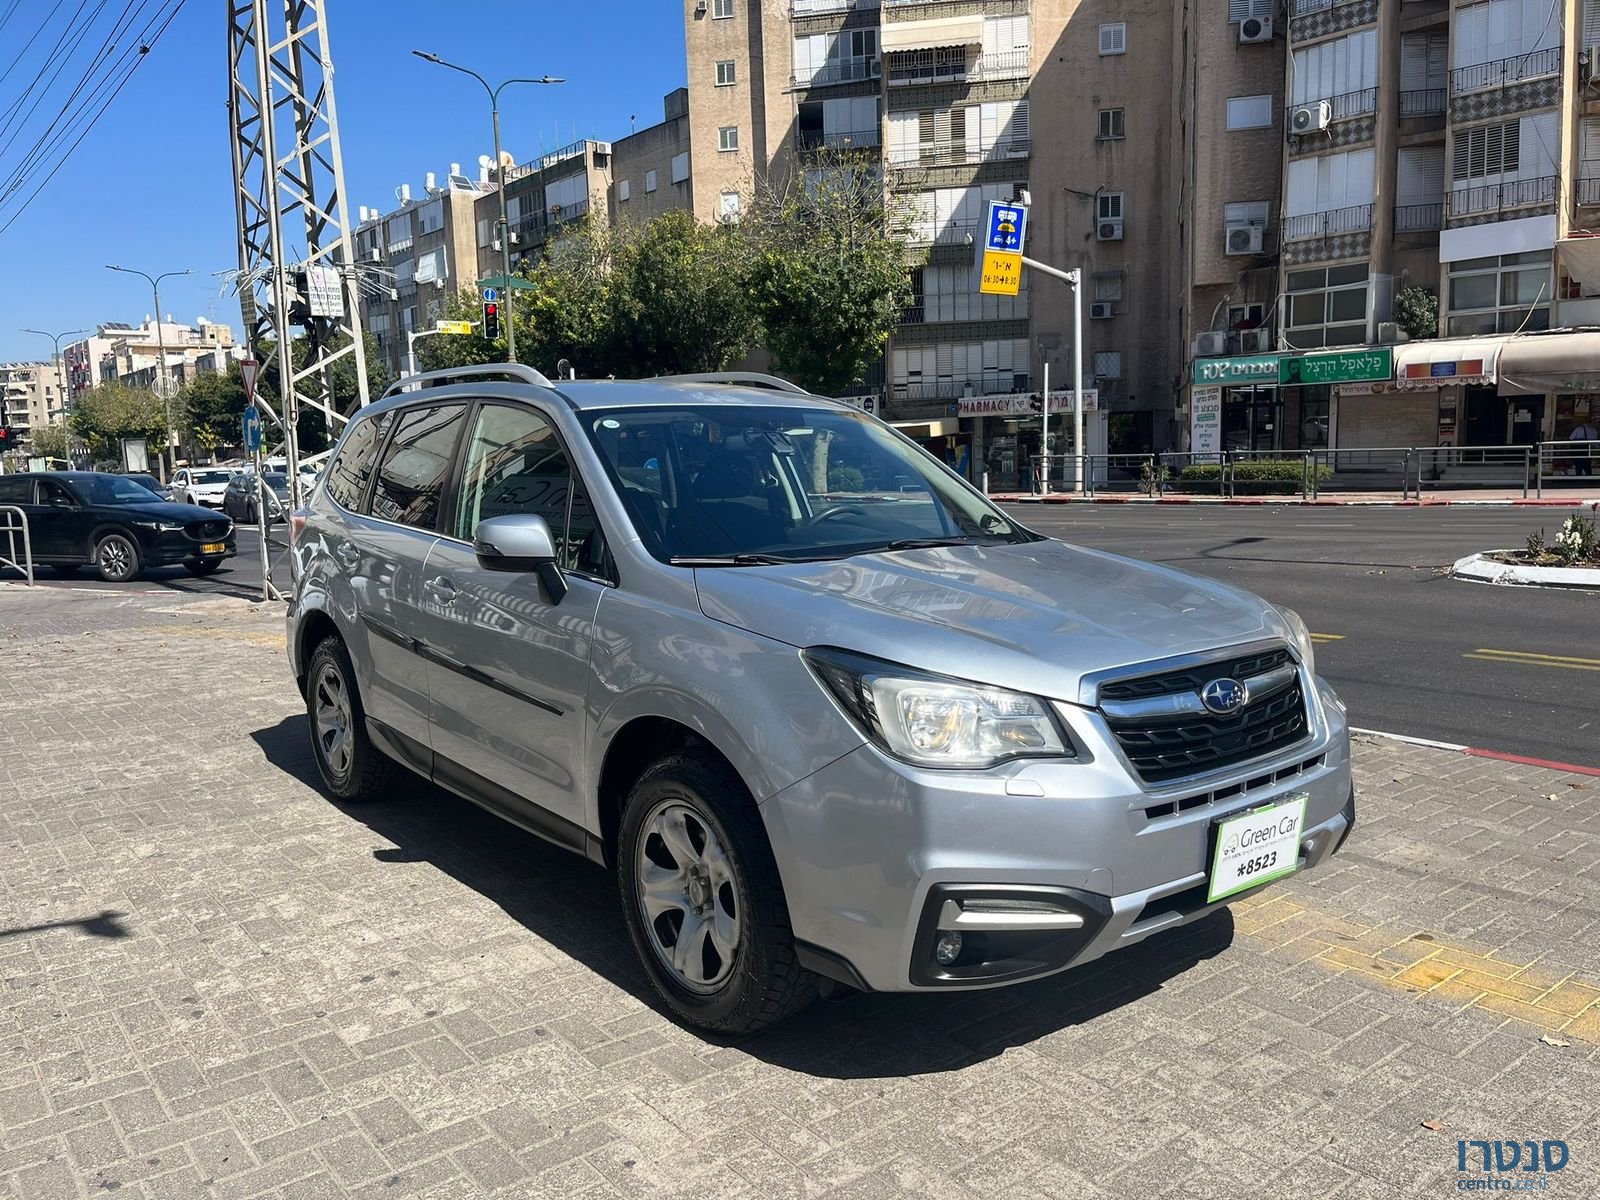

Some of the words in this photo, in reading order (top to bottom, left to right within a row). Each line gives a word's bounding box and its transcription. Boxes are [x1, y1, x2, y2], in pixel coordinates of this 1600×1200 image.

[957, 399, 1010, 413] PHARMACY
[1240, 824, 1277, 848] Green
[1278, 816, 1299, 835] Car
